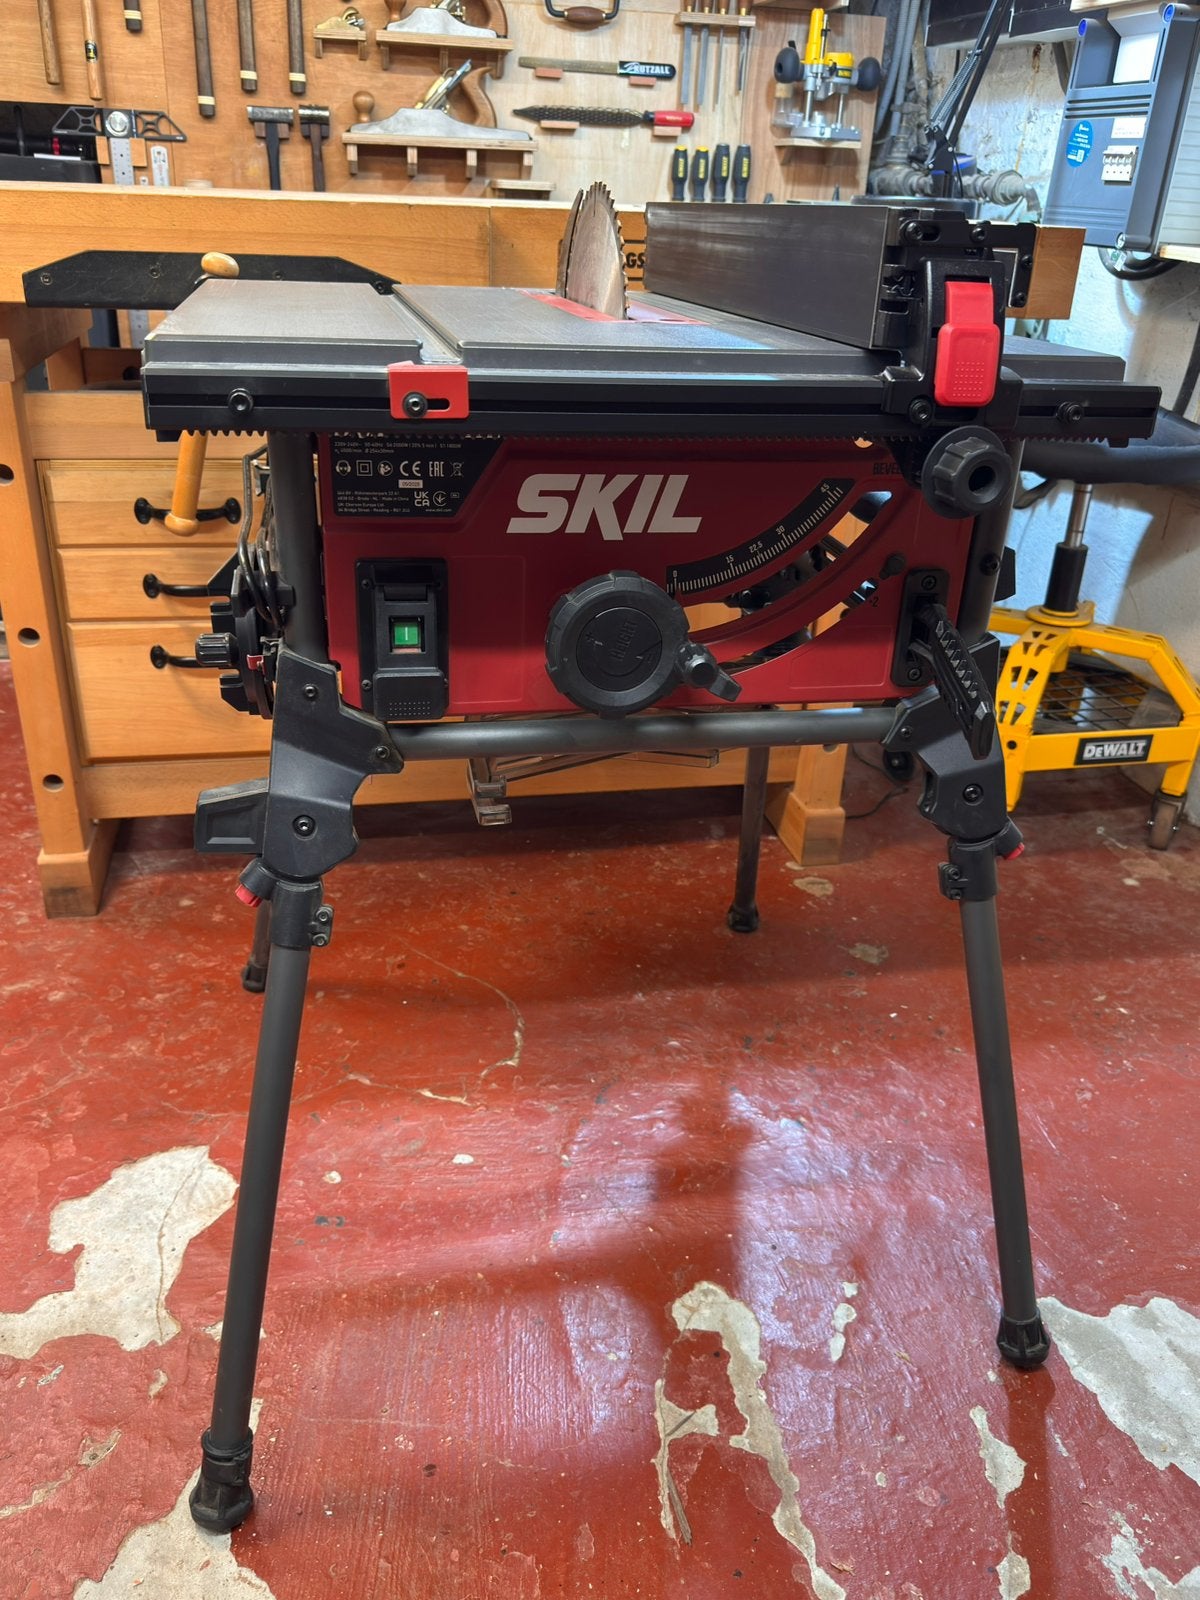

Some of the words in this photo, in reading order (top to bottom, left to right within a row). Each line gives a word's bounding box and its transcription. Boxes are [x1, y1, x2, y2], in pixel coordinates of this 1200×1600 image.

[820, 483, 830, 493] 45
[414, 491, 429, 499] UK
[414, 499, 430, 507] CA
[506, 473, 703, 541] SKIL
[775, 525, 785, 535] 30
[749, 541, 763, 553] 22.5
[726, 554, 735, 564] 15
